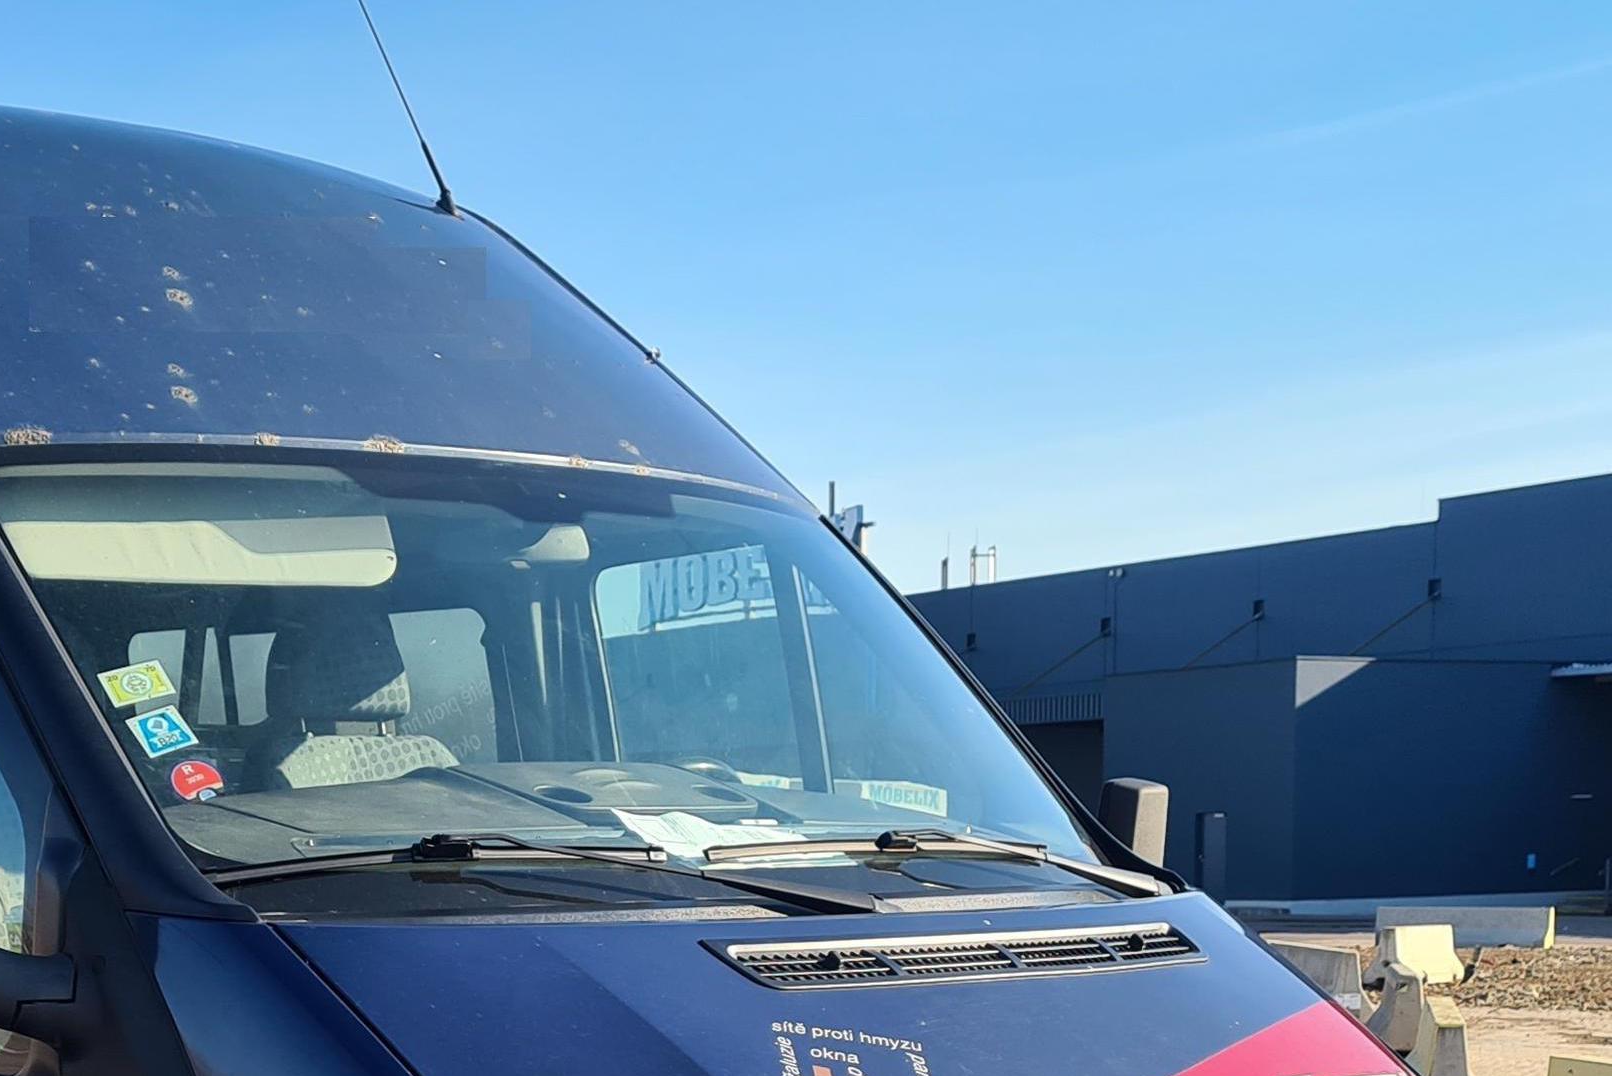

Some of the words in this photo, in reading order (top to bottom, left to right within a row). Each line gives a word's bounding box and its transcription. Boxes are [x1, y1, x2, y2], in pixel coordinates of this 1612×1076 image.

[772, 1021, 806, 1035] sítě
[811, 1026, 854, 1041] proti
[859, 1032, 923, 1052] hmyzu
[810, 1047, 860, 1065] okna
